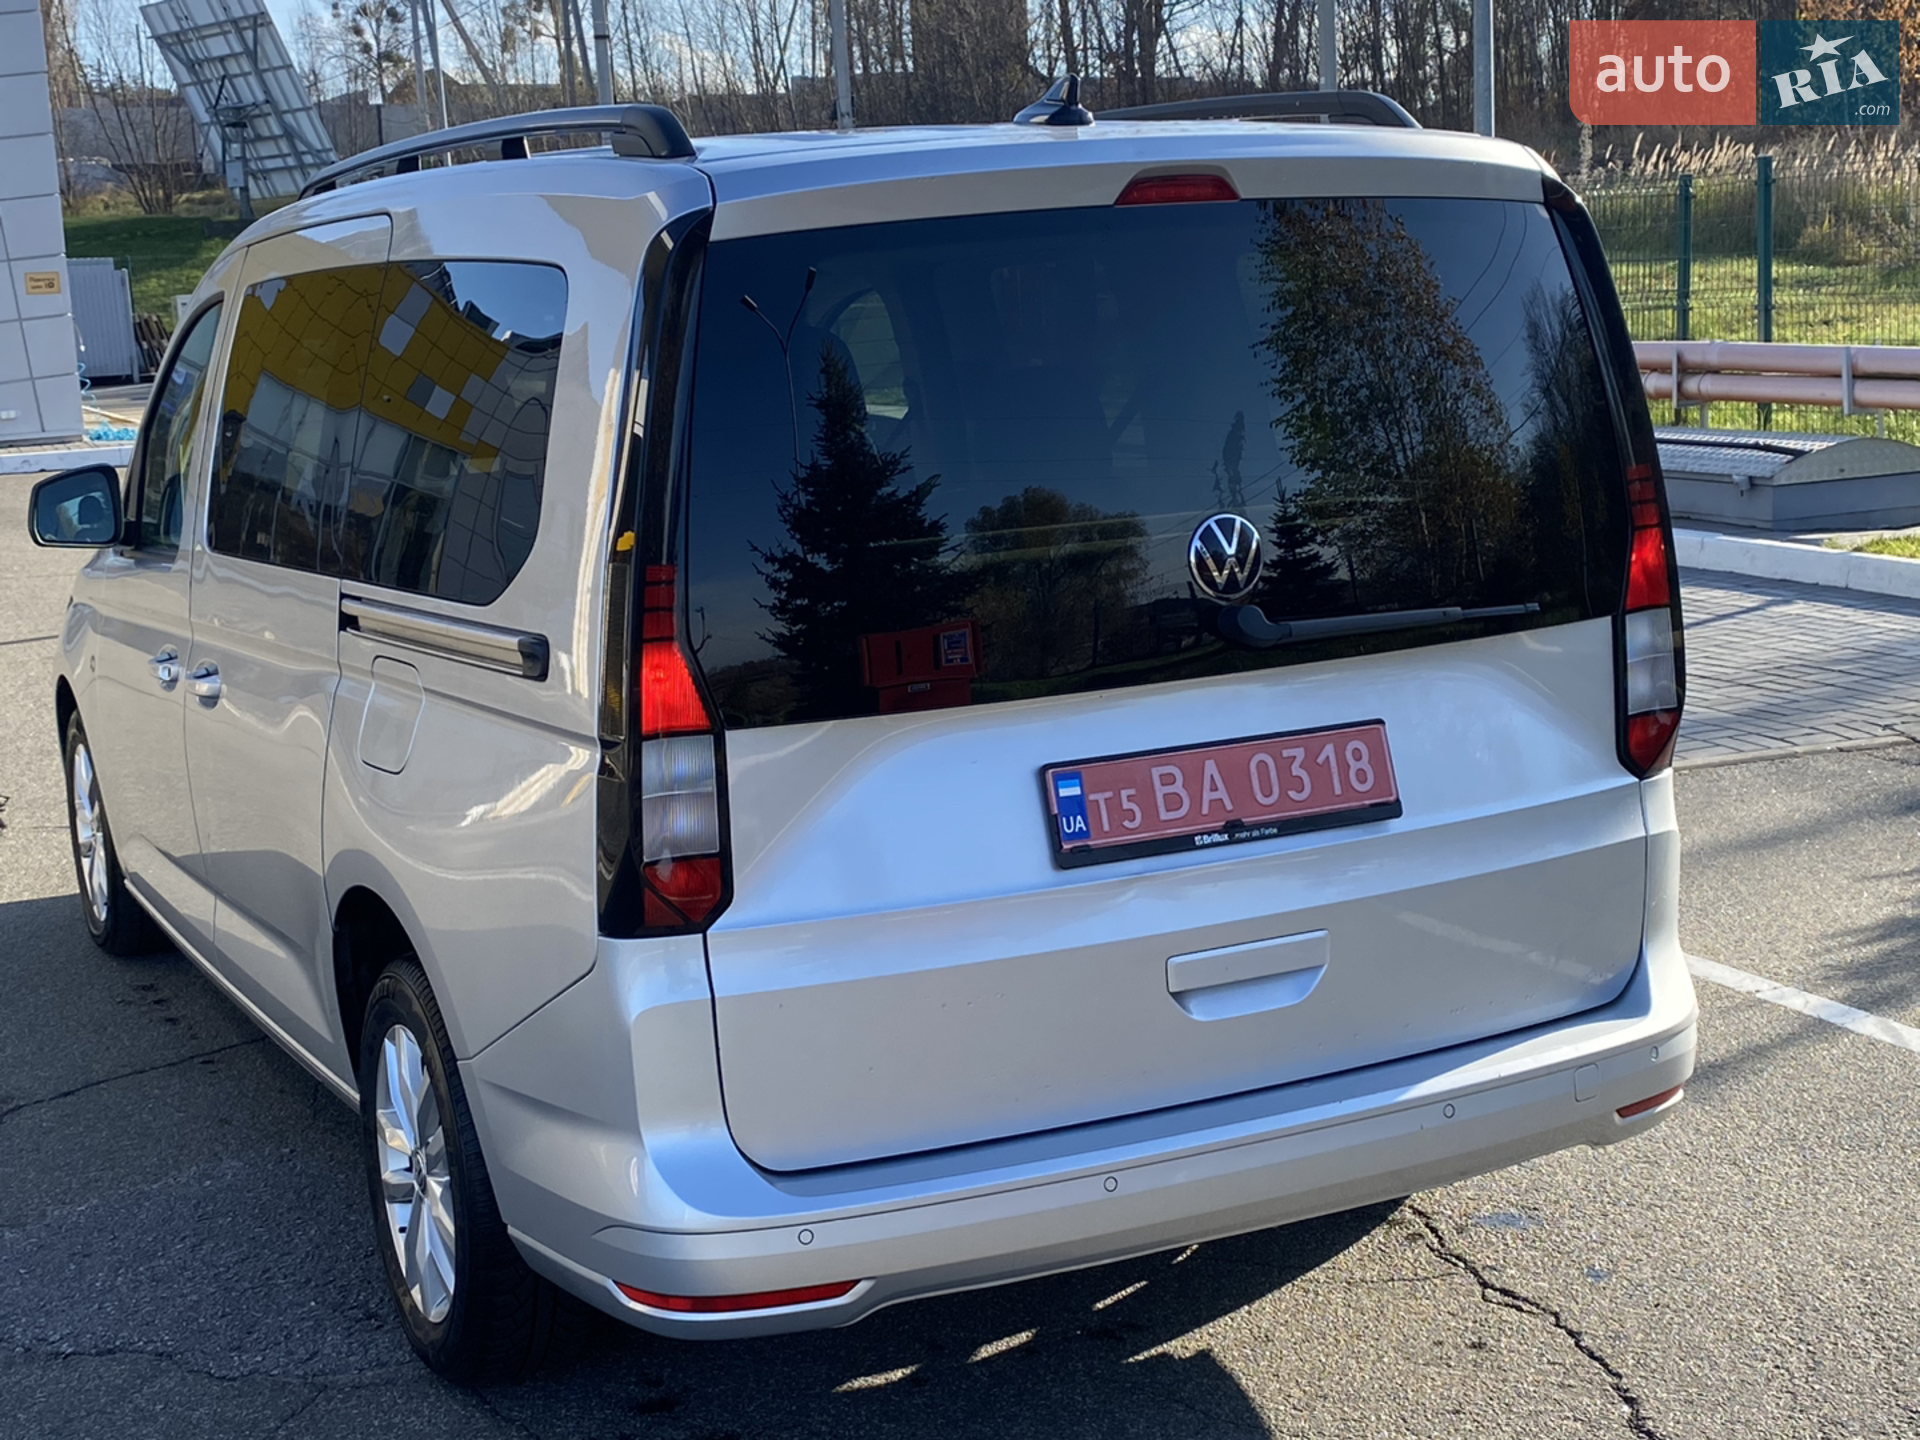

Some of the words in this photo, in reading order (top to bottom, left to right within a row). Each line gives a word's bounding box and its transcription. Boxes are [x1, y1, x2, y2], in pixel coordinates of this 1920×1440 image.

[1088, 788, 1142, 833] T5
[1151, 759, 1234, 822] BA
[1249, 740, 1375, 806] 0318
[1062, 815, 1087, 834] UA
